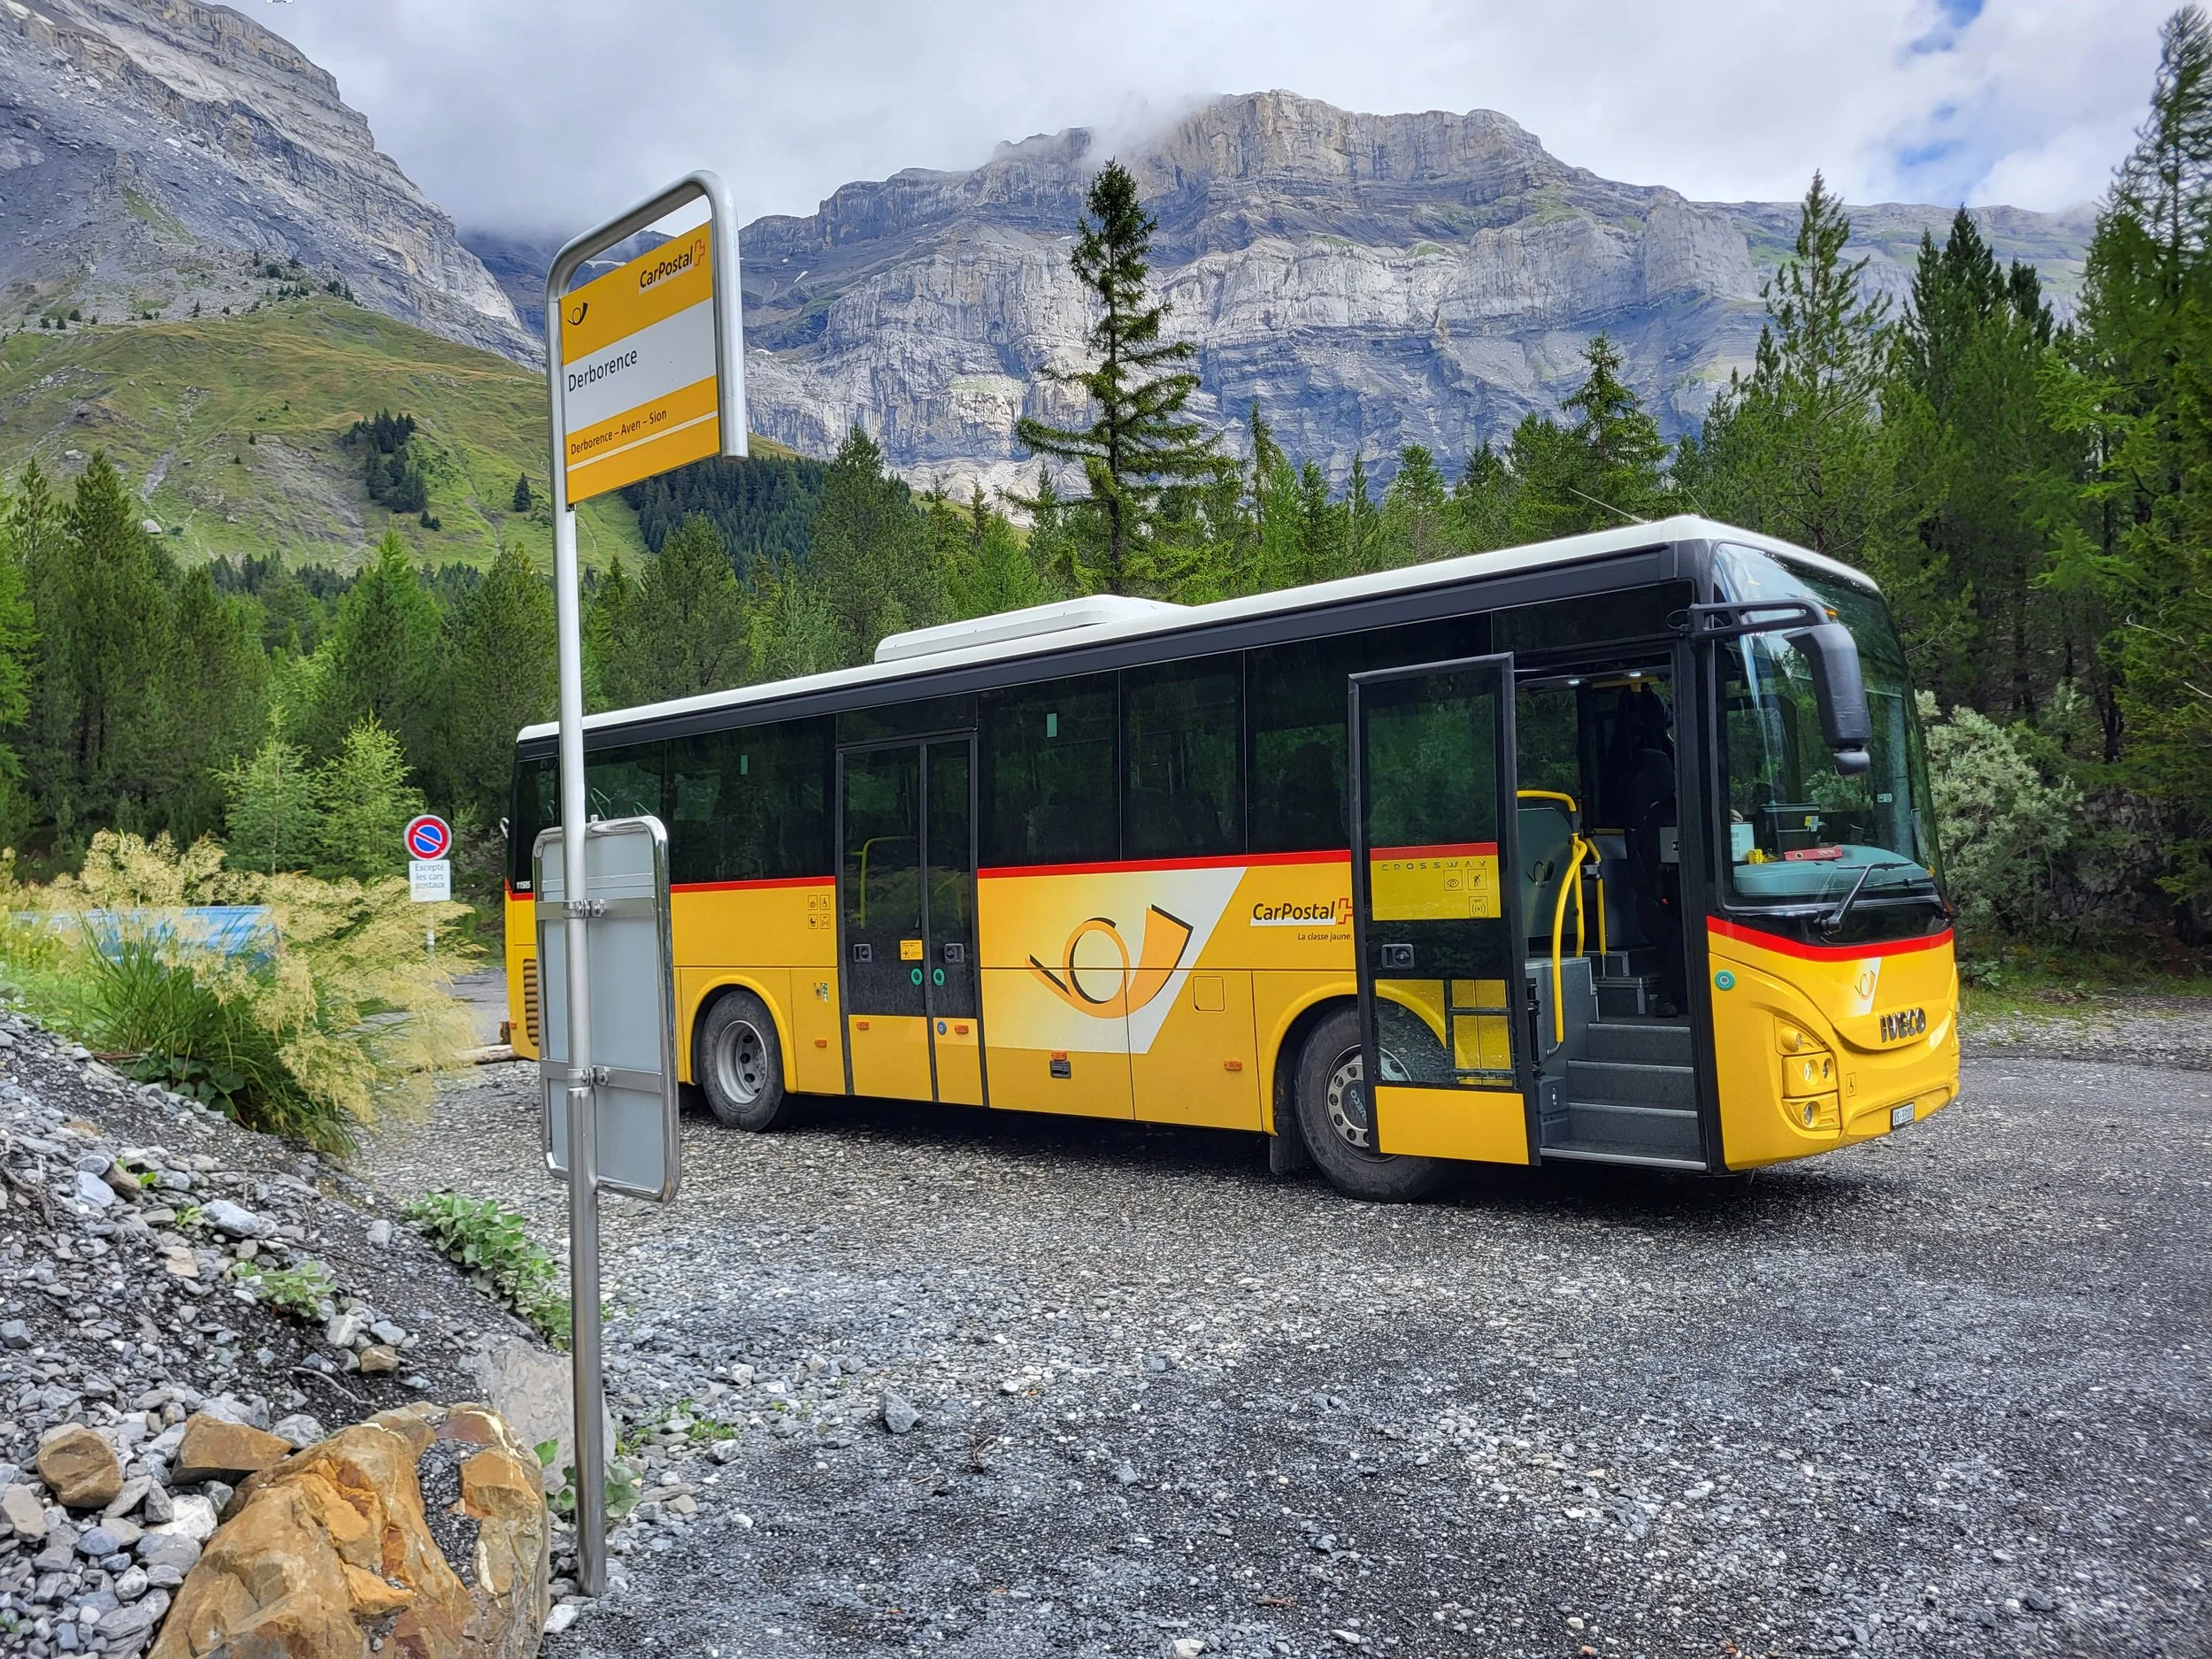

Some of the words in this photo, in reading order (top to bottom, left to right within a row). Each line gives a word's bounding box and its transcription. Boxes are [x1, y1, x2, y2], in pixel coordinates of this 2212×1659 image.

[640, 251, 693, 288] CarPostal
[568, 349, 637, 392] Derborence
[571, 433, 613, 455] Derborence
[621, 419, 641, 436] Aven
[649, 409, 667, 426] Sion
[415, 863, 446, 873] Excepté
[1381, 859, 1486, 872] CROSSWAY
[415, 881, 445, 890] postaux
[1252, 900, 1336, 921] CarPostal
[1880, 1007, 1926, 1042] IVECO
